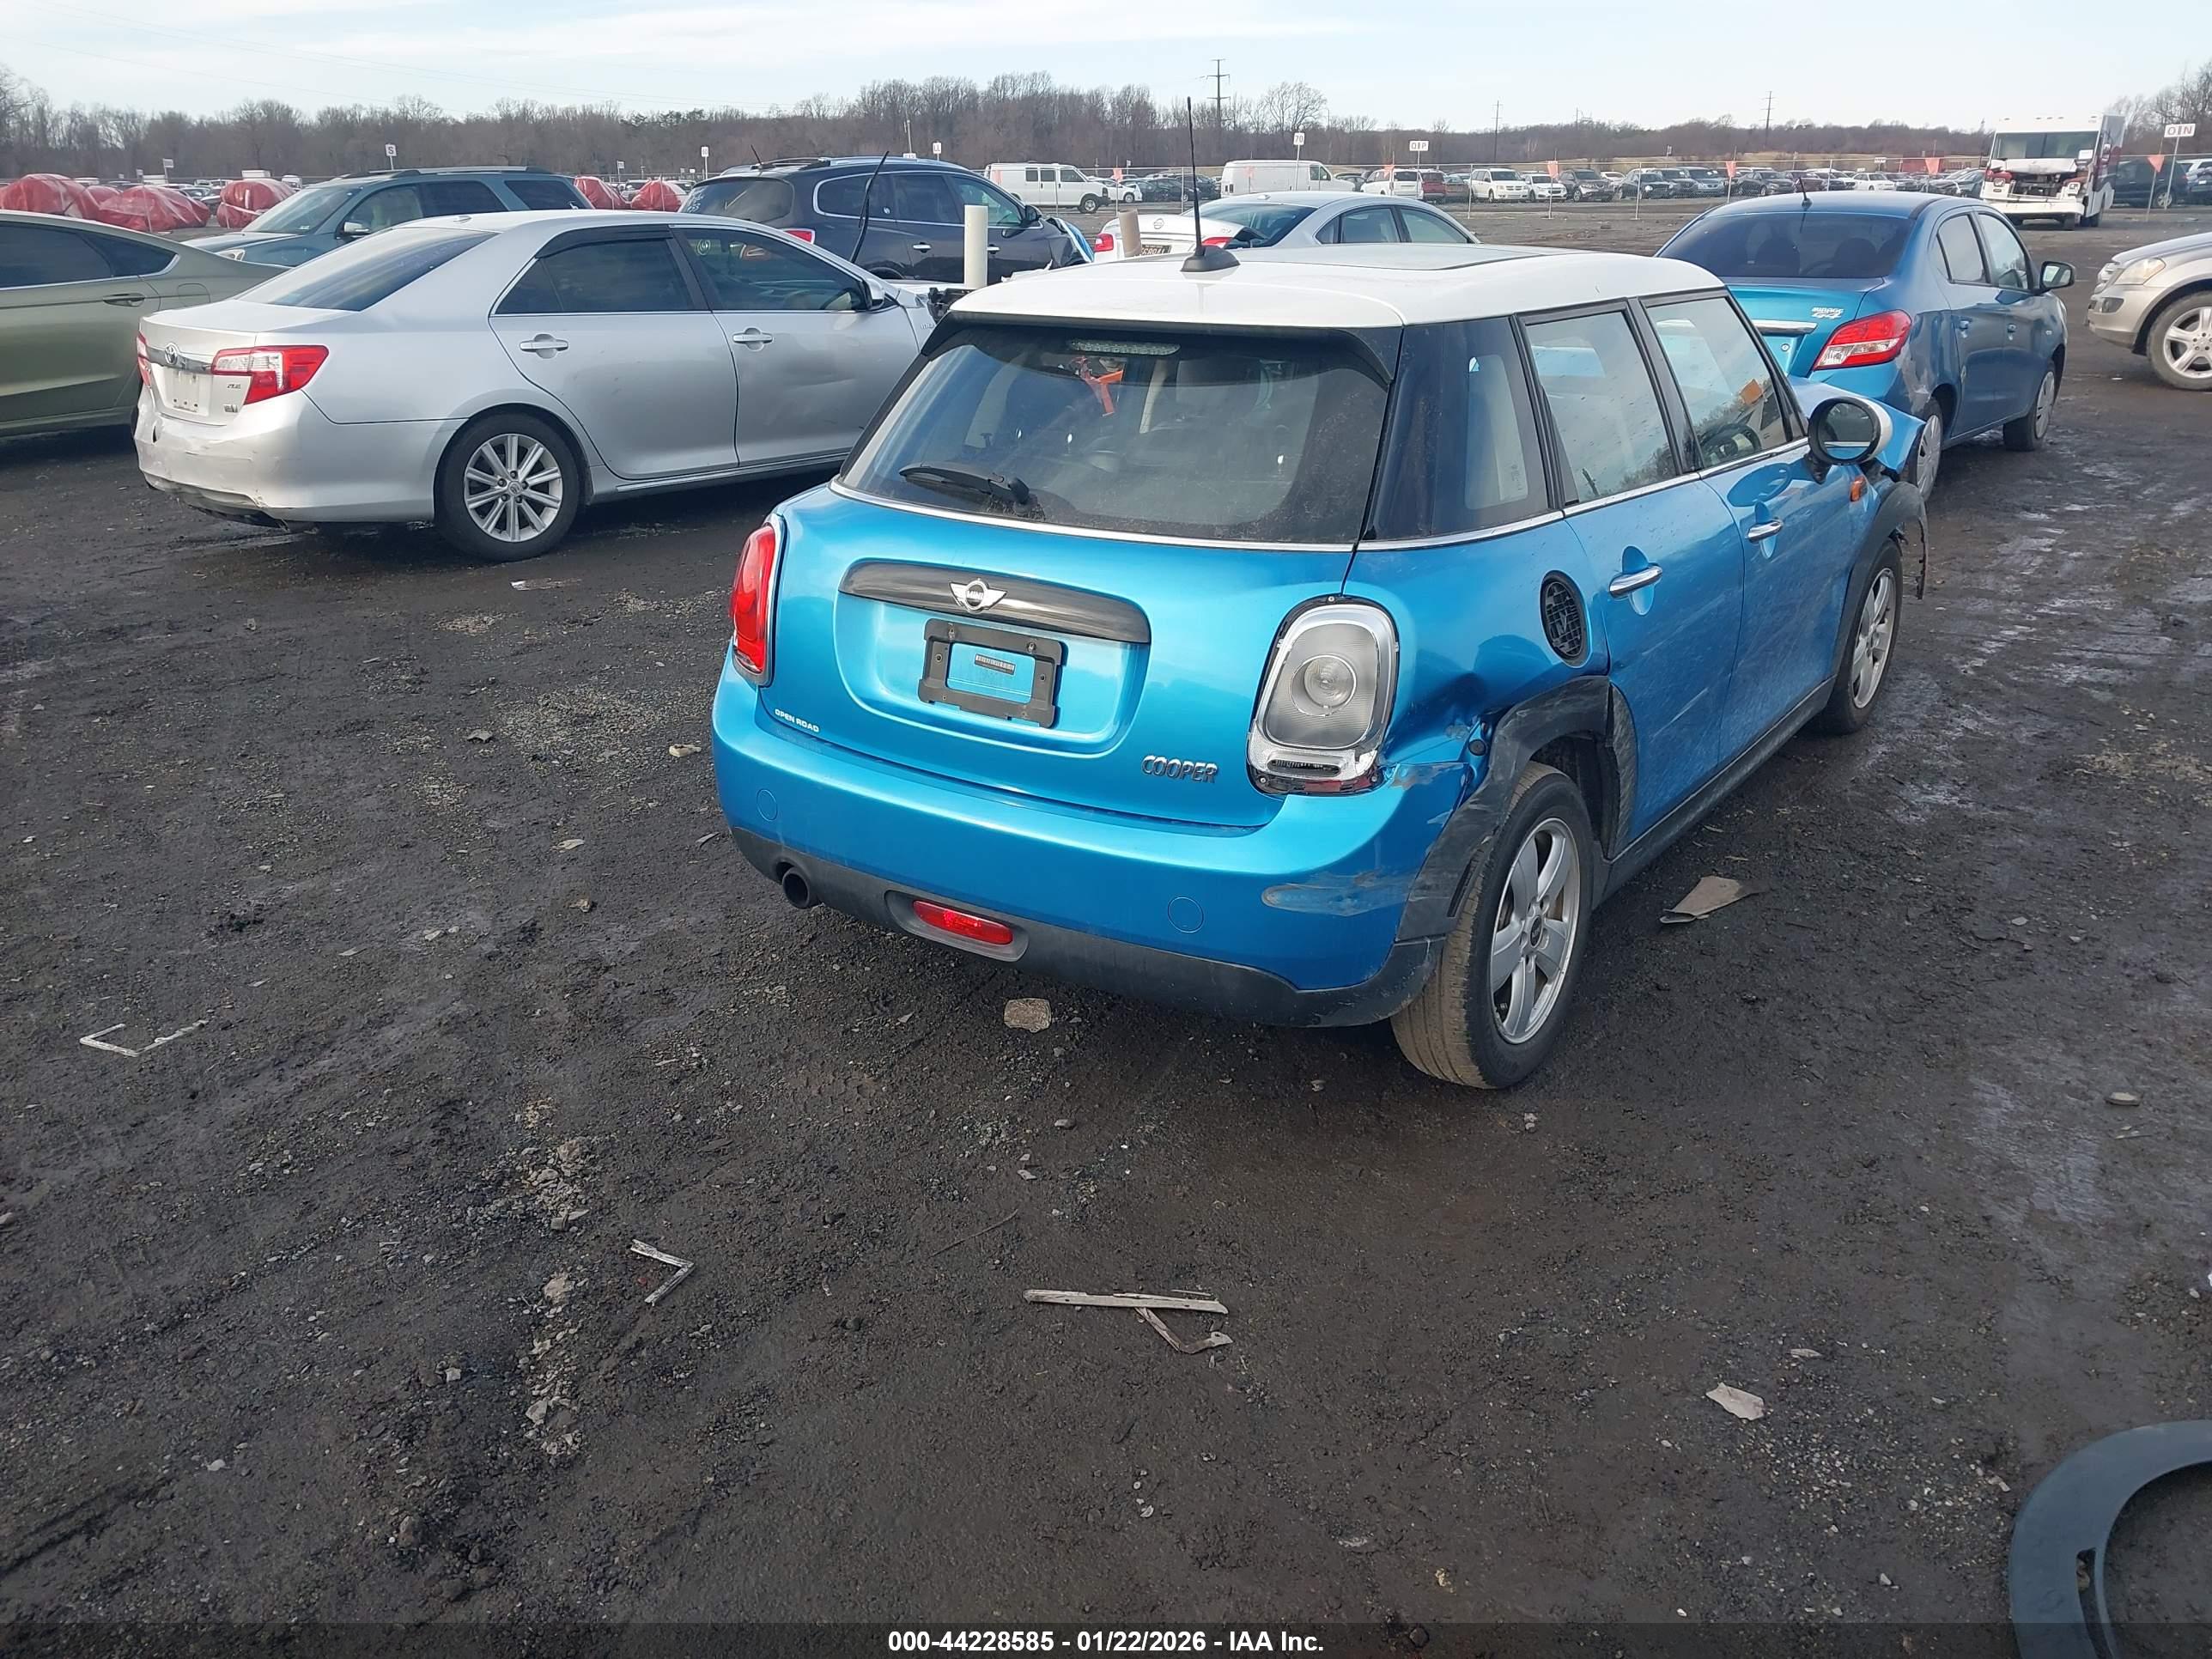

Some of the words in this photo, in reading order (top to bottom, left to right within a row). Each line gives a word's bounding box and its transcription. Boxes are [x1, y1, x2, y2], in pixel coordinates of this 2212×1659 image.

[775, 708, 795, 723] OPEN
[795, 718, 819, 732] ROAD
[1141, 755, 1218, 783] COOPER
